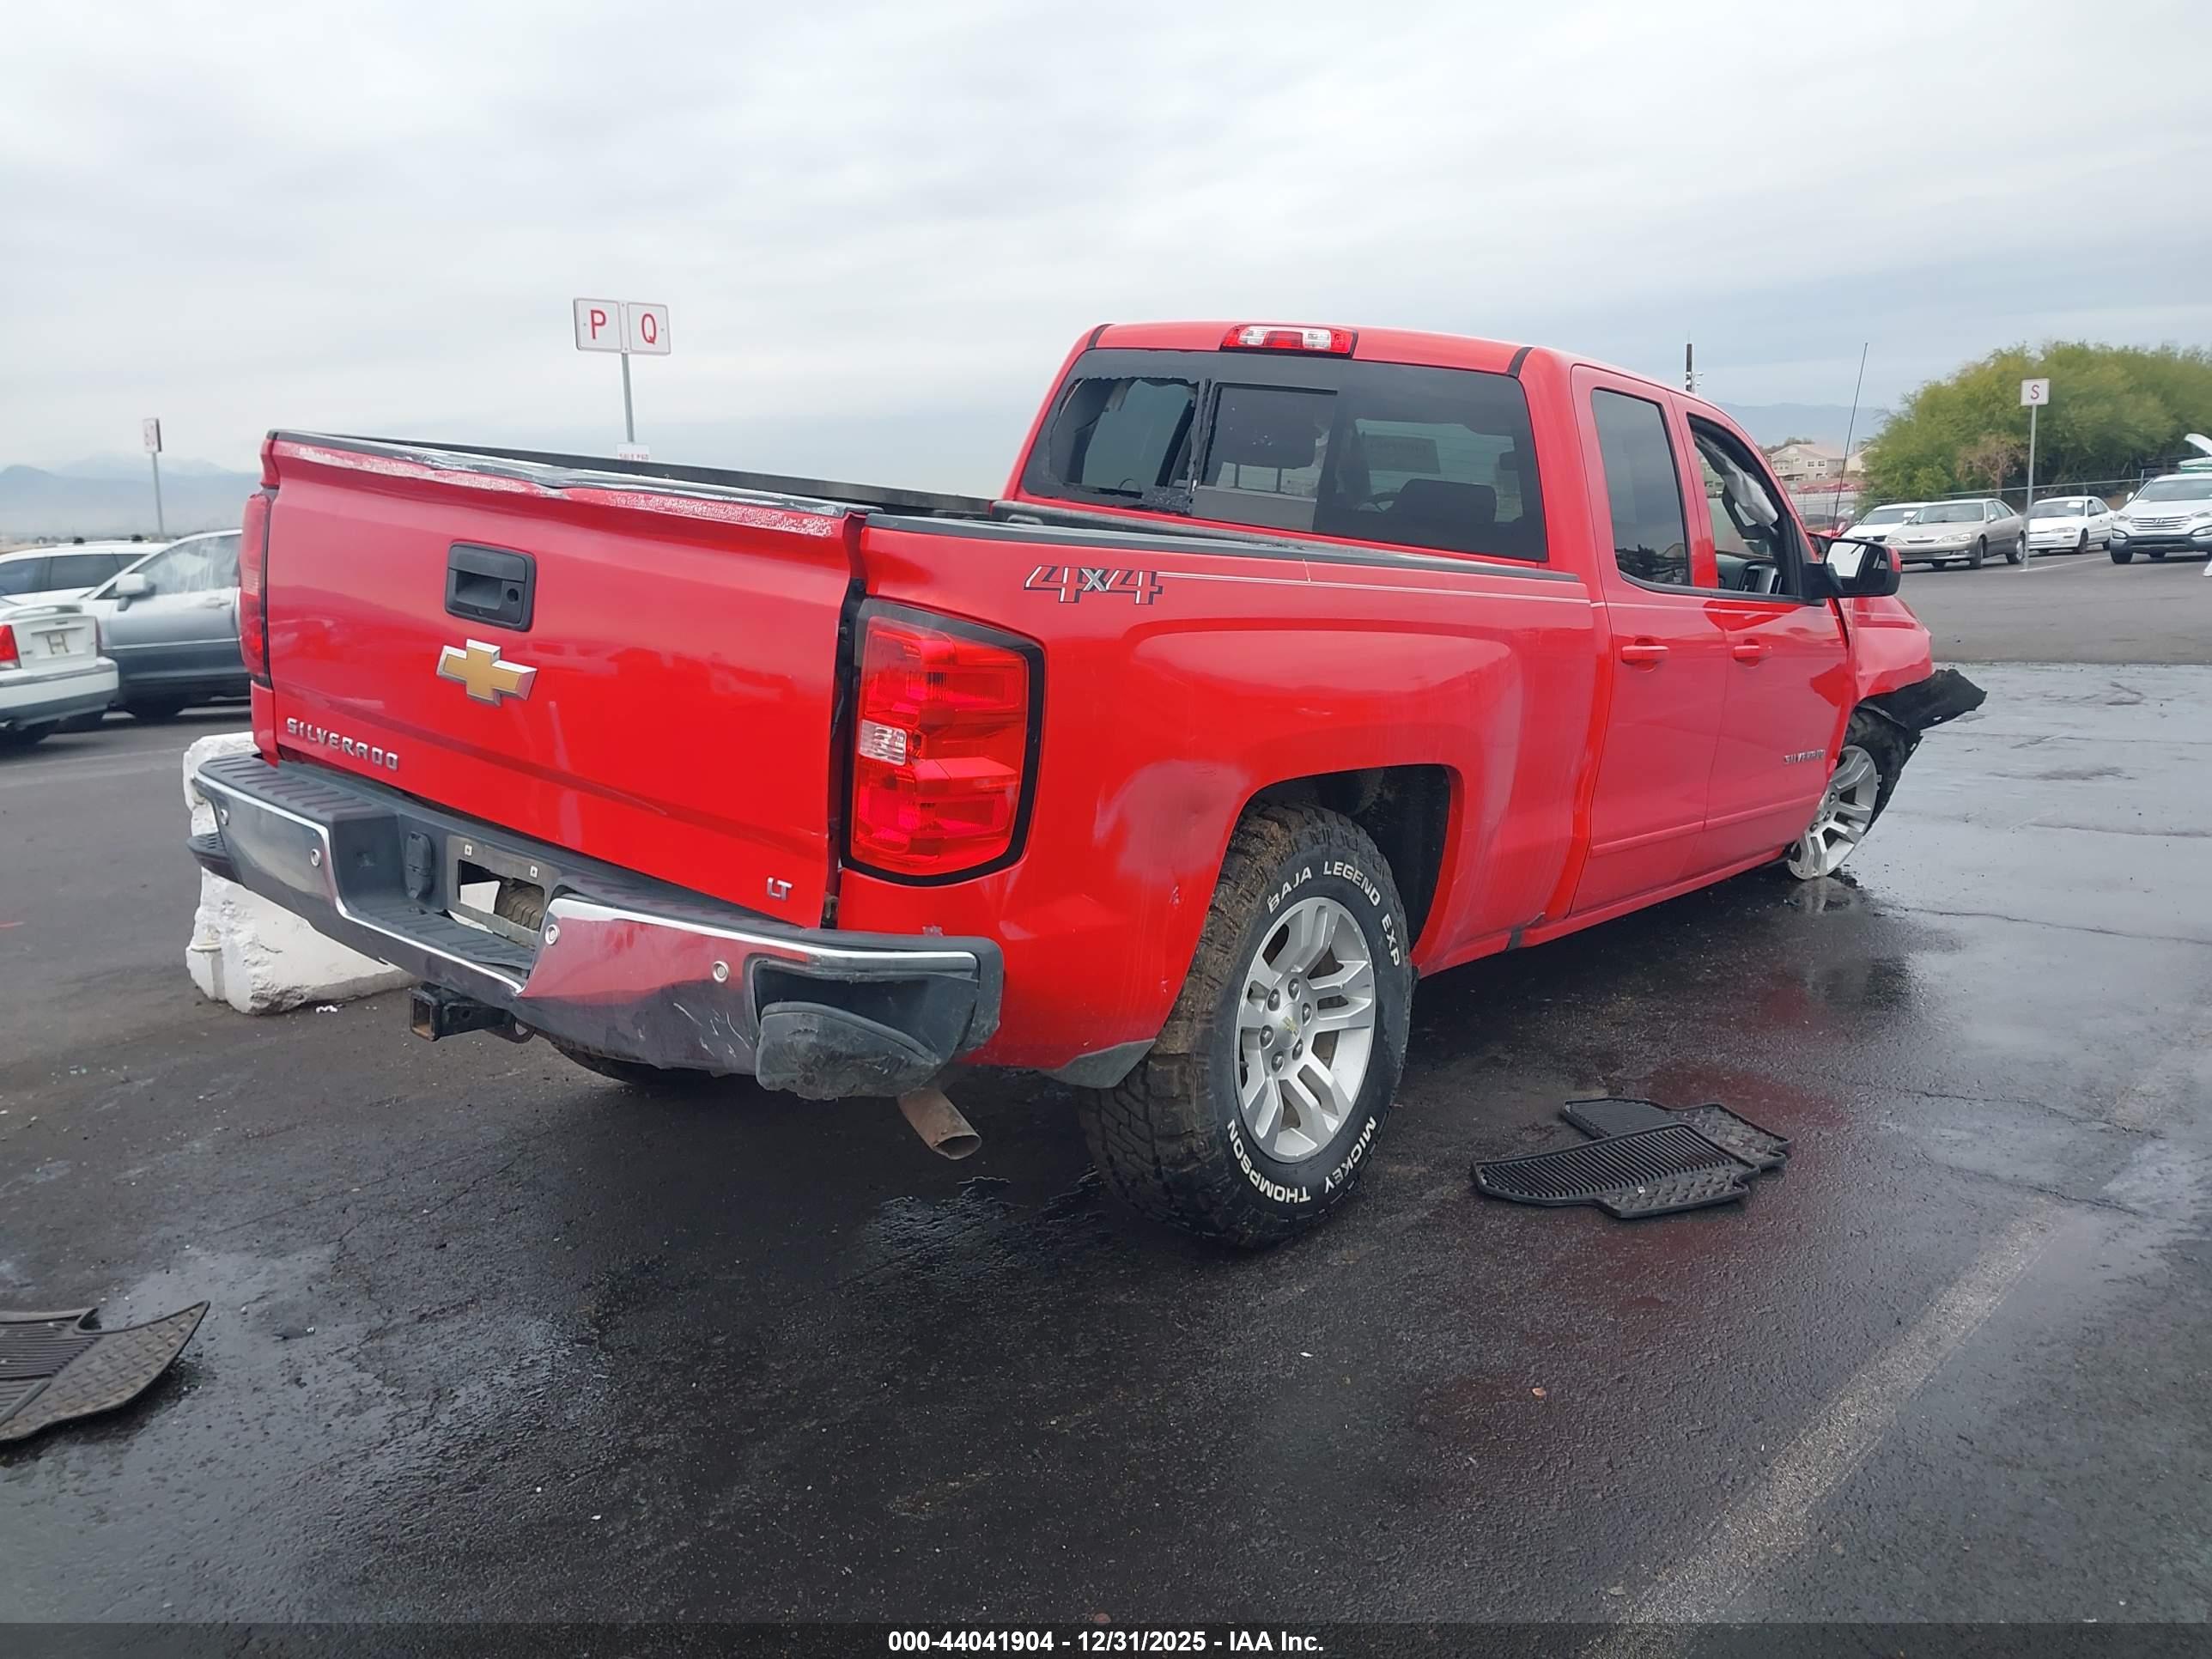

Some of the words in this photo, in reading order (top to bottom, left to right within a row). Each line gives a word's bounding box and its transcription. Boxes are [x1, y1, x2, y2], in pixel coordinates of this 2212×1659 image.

[590, 309, 606, 340] P
[641, 313, 657, 344] Q
[2030, 384, 2040, 400] S
[286, 717, 399, 771] SILVERADO
[767, 876, 793, 902] LT
[1267, 866, 1313, 915] BAJA
[1322, 860, 1382, 908] LEGEND
[1381, 913, 1401, 967] EXP
[1226, 1119, 1311, 1204] THOMPSON
[1323, 1116, 1377, 1194] MICKEY
